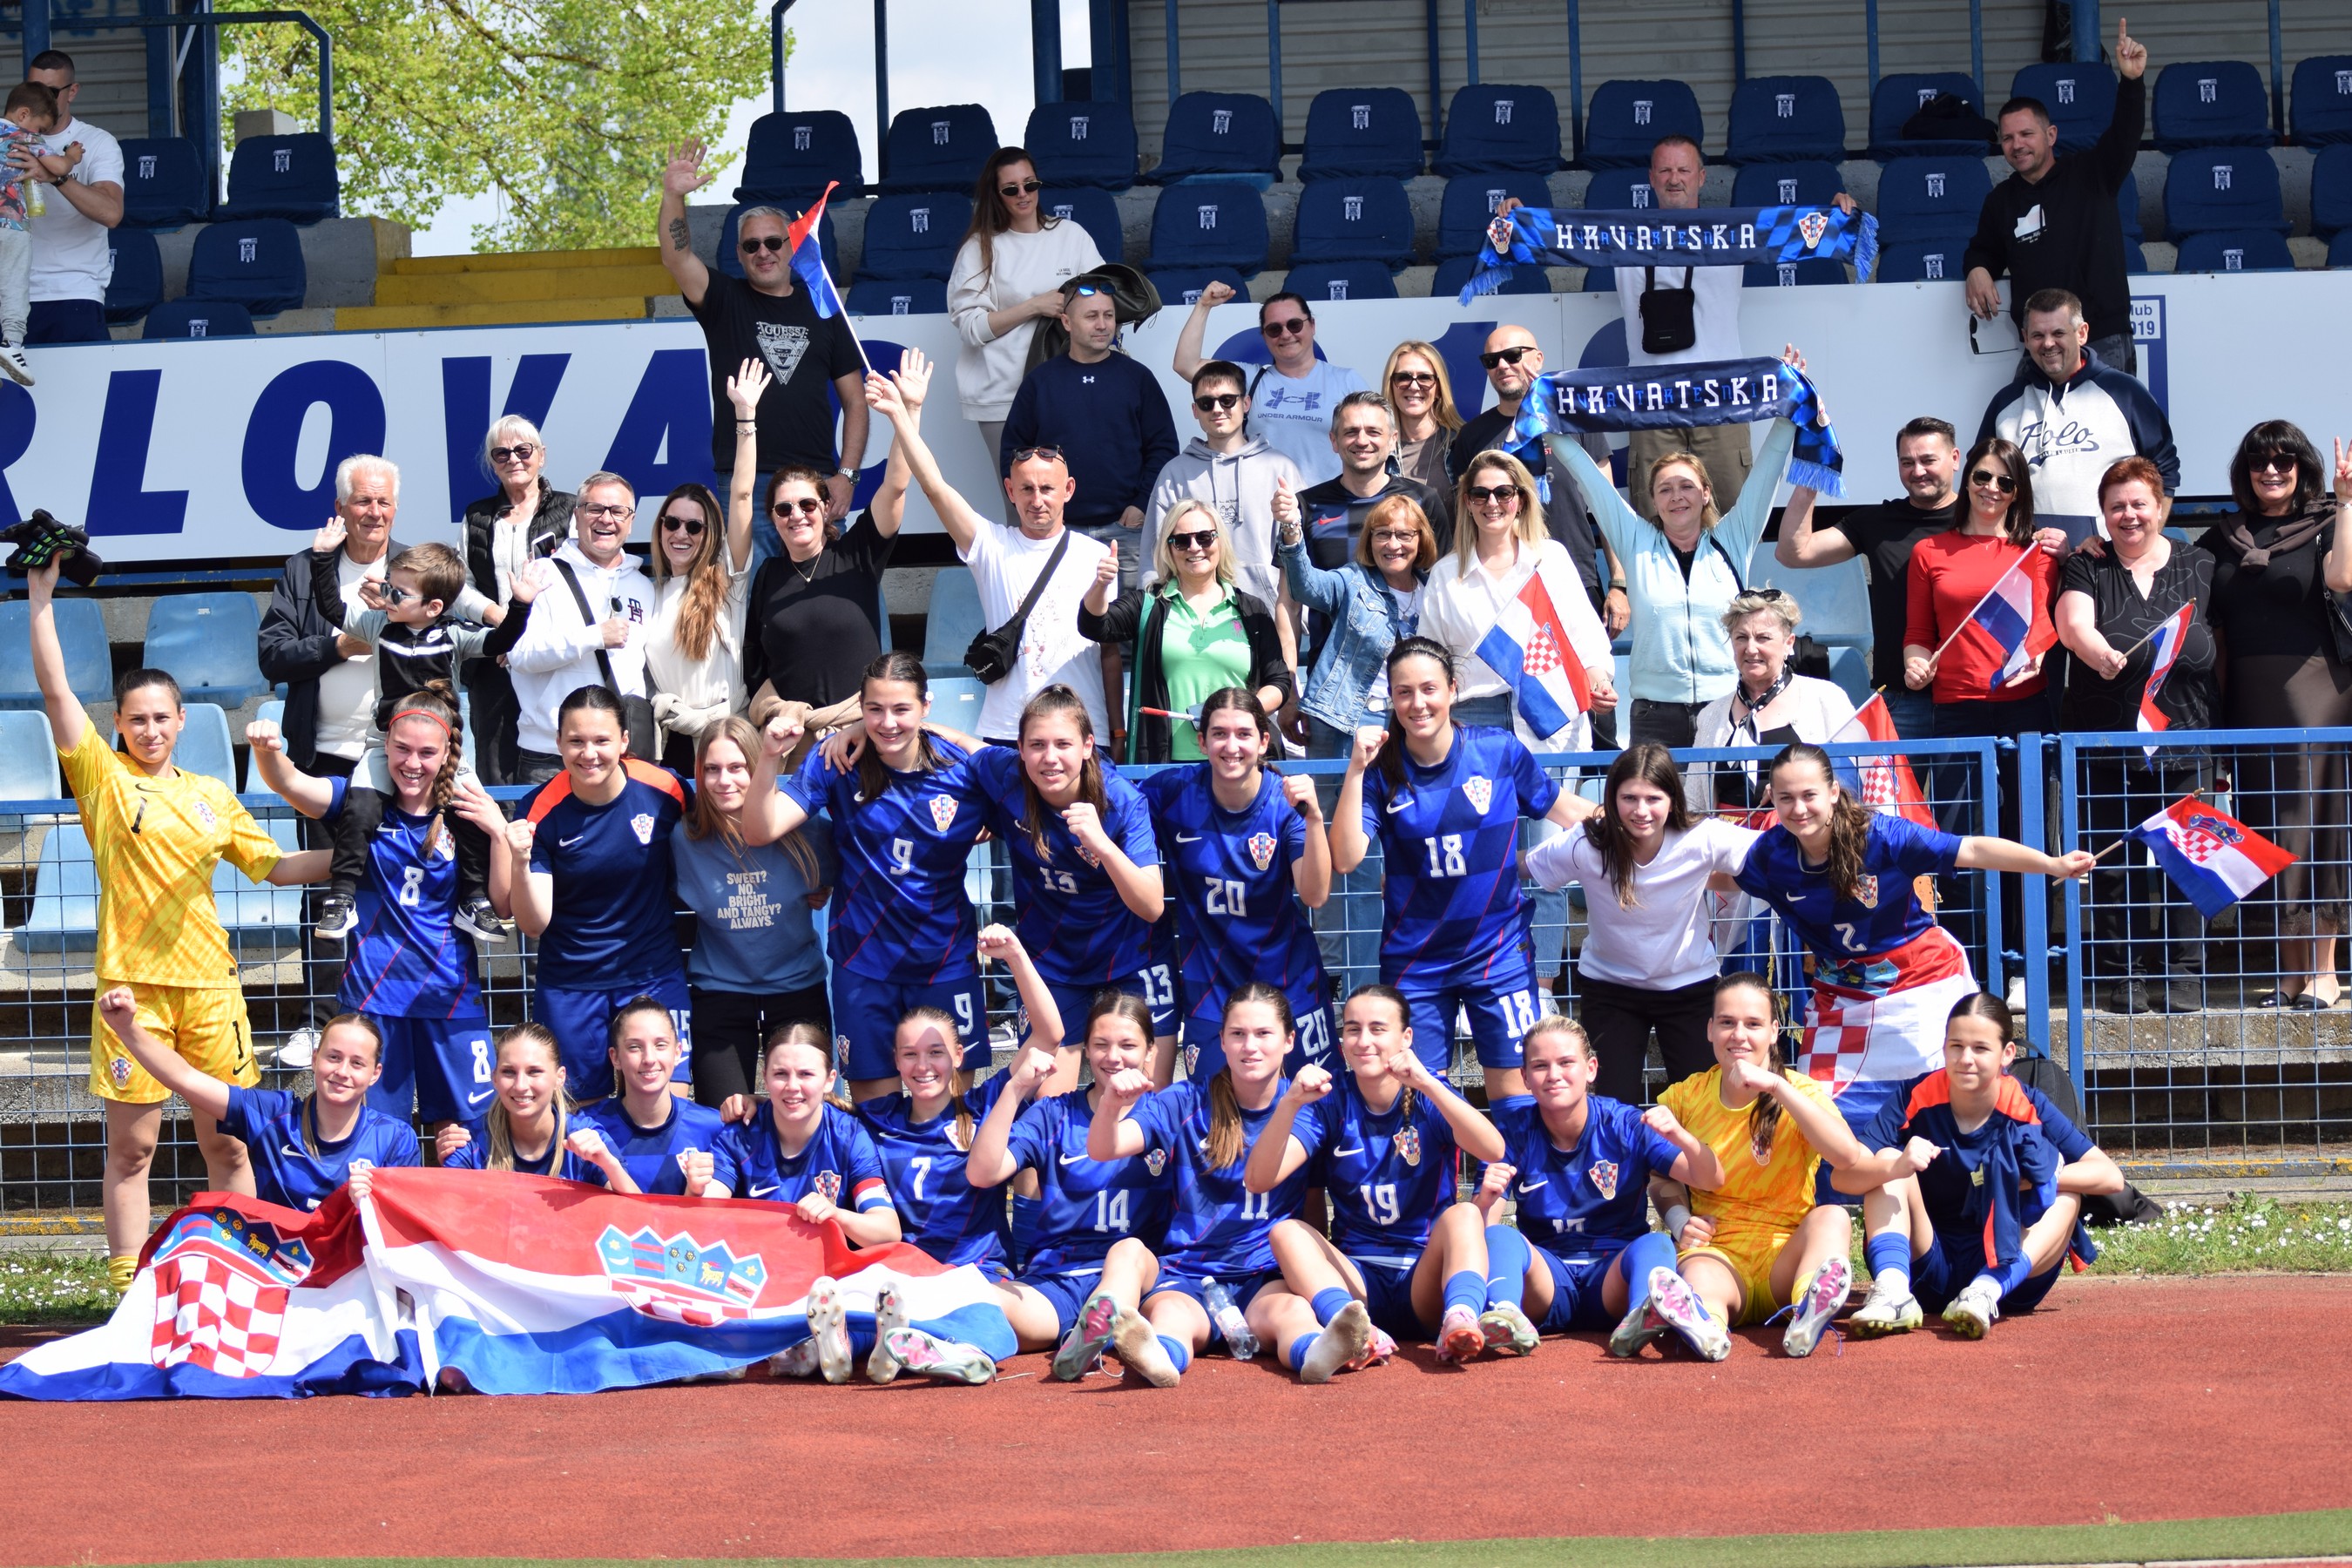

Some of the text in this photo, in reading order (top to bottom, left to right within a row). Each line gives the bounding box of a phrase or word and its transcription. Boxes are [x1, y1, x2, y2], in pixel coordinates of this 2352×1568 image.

[1556, 224, 1756, 251] HRVATSKA
[2131, 303, 2153, 315] lub
[2131, 321, 2155, 335] 919
[765, 325, 801, 336] GUESS
[1556, 374, 1778, 415] HRVATSKA
[1286, 414, 1323, 423] ARMOUR
[2020, 420, 2093, 451] Polo
[131, 796, 148, 836] 1
[889, 837, 914, 876] 9
[1424, 834, 1467, 878] 18
[399, 865, 425, 908] 8
[726, 870, 767, 885] SWEET?
[738, 883, 756, 896] NO.
[1205, 876, 1247, 917] 20
[717, 903, 782, 919] AND TANGY?
[728, 894, 767, 907] BRIGHT
[730, 916, 774, 929] ALWAYS.
[1833, 923, 1868, 952] 2
[1138, 963, 1174, 1006] 13
[954, 992, 974, 1035] 9
[1296, 1006, 1331, 1057] 20
[1498, 989, 1538, 1038] 18
[232, 1019, 244, 1060] 1
[470, 1039, 492, 1083] 8
[911, 1157, 931, 1200] 7
[1094, 1189, 1131, 1233] 14
[1240, 1179, 1270, 1220] 11
[1360, 1183, 1400, 1226] 19
